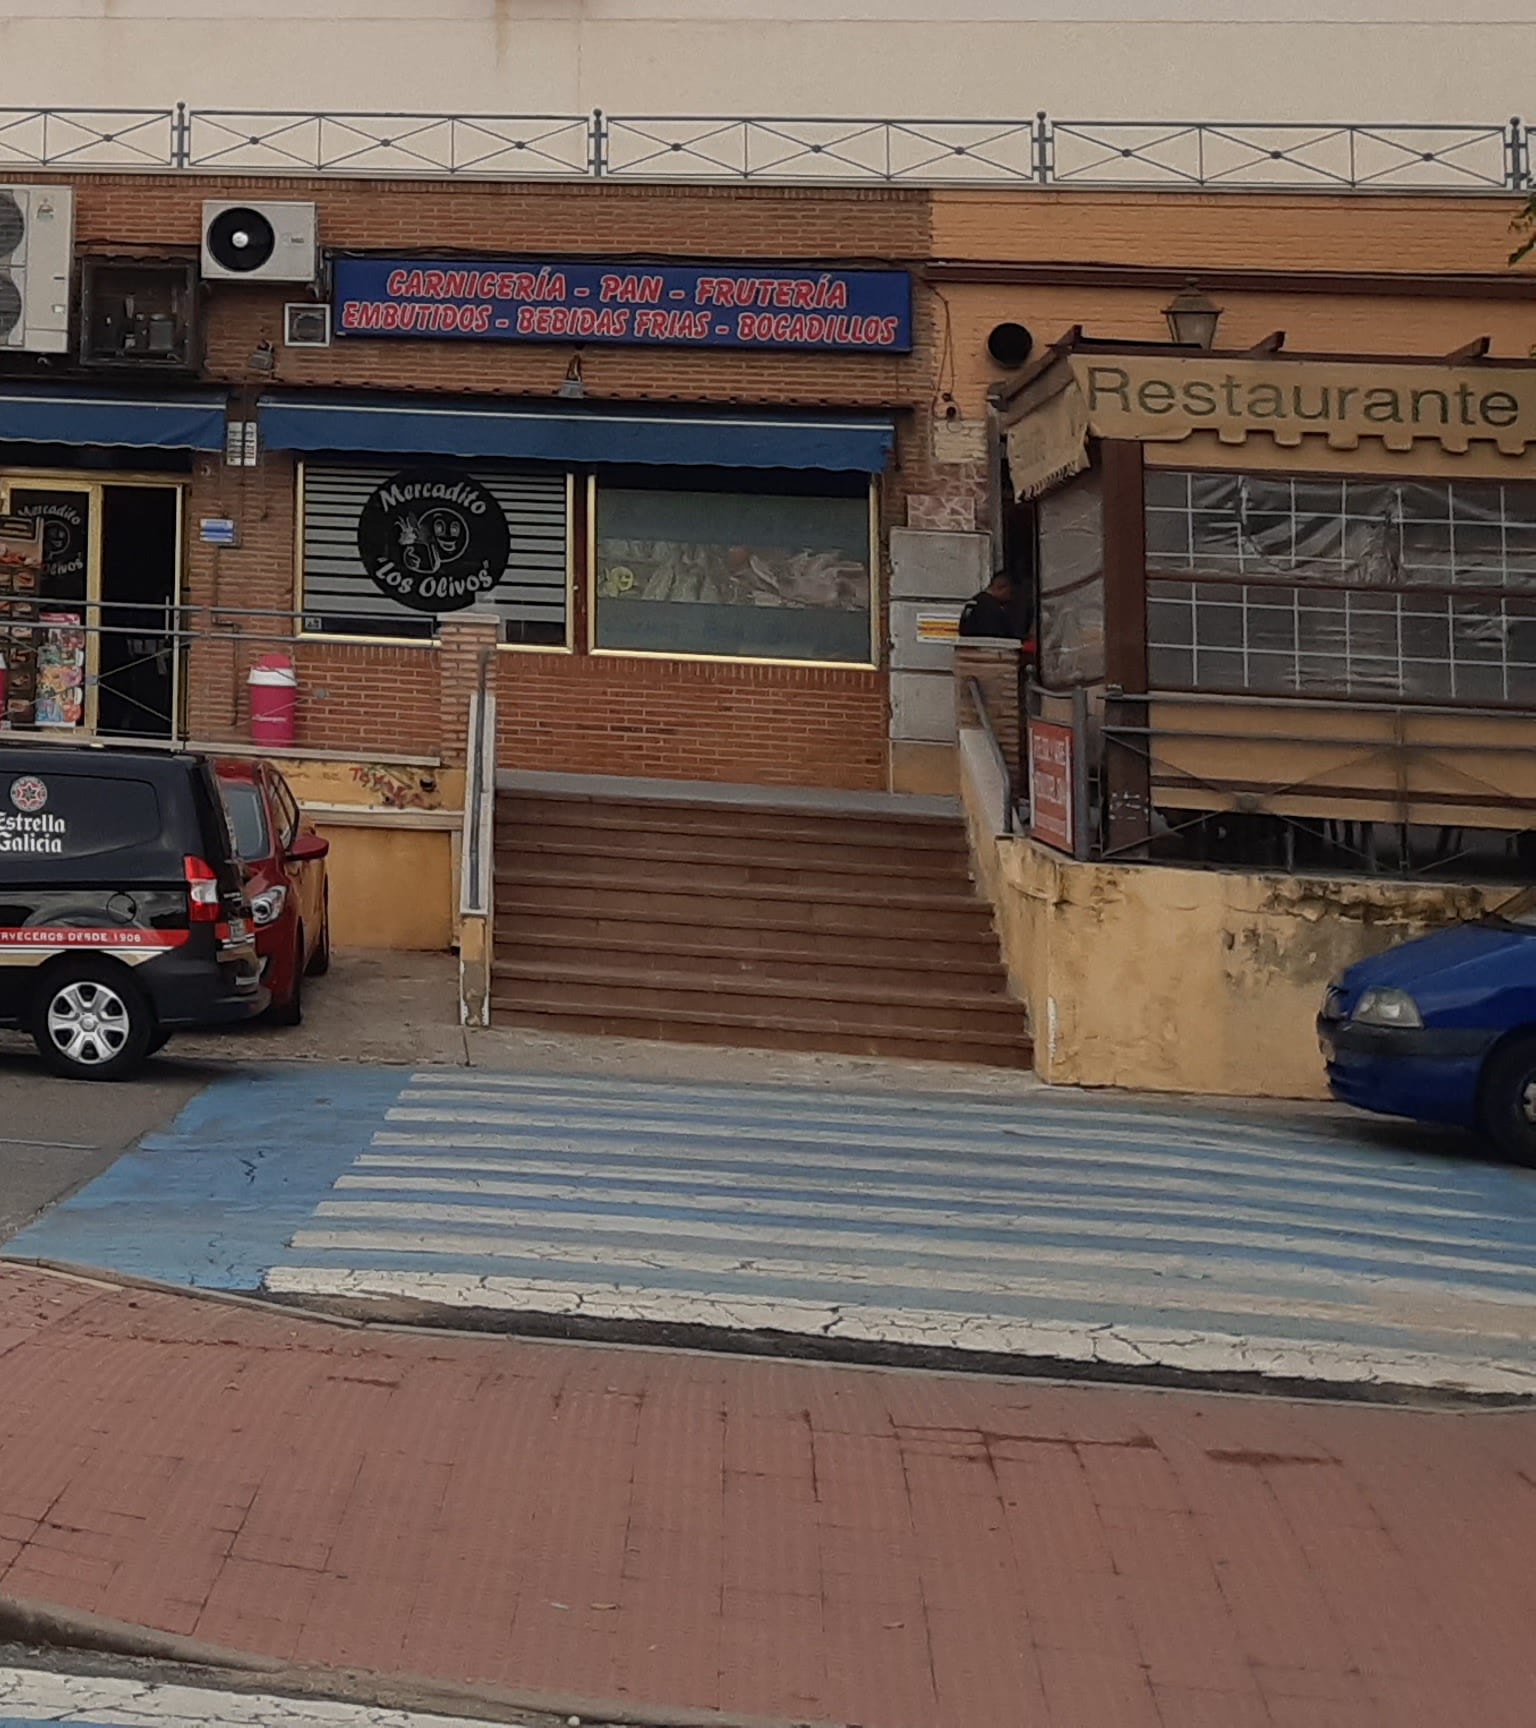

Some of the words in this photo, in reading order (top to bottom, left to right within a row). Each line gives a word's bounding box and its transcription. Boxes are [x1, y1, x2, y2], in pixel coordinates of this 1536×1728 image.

[387, 267, 566, 302] CARNICERÍA
[600, 276, 663, 304] PAN
[695, 275, 847, 309] FRUTERÍA
[341, 303, 492, 332] EMBUTIDOS
[516, 306, 629, 337] BEBIDAS
[634, 310, 711, 340] FRIAS
[737, 311, 898, 346] BOCADILLOS
[1086, 366, 1520, 428] Restaurante
[379, 482, 486, 514] Mercadito
[68, 932, 108, 942] DESDE
